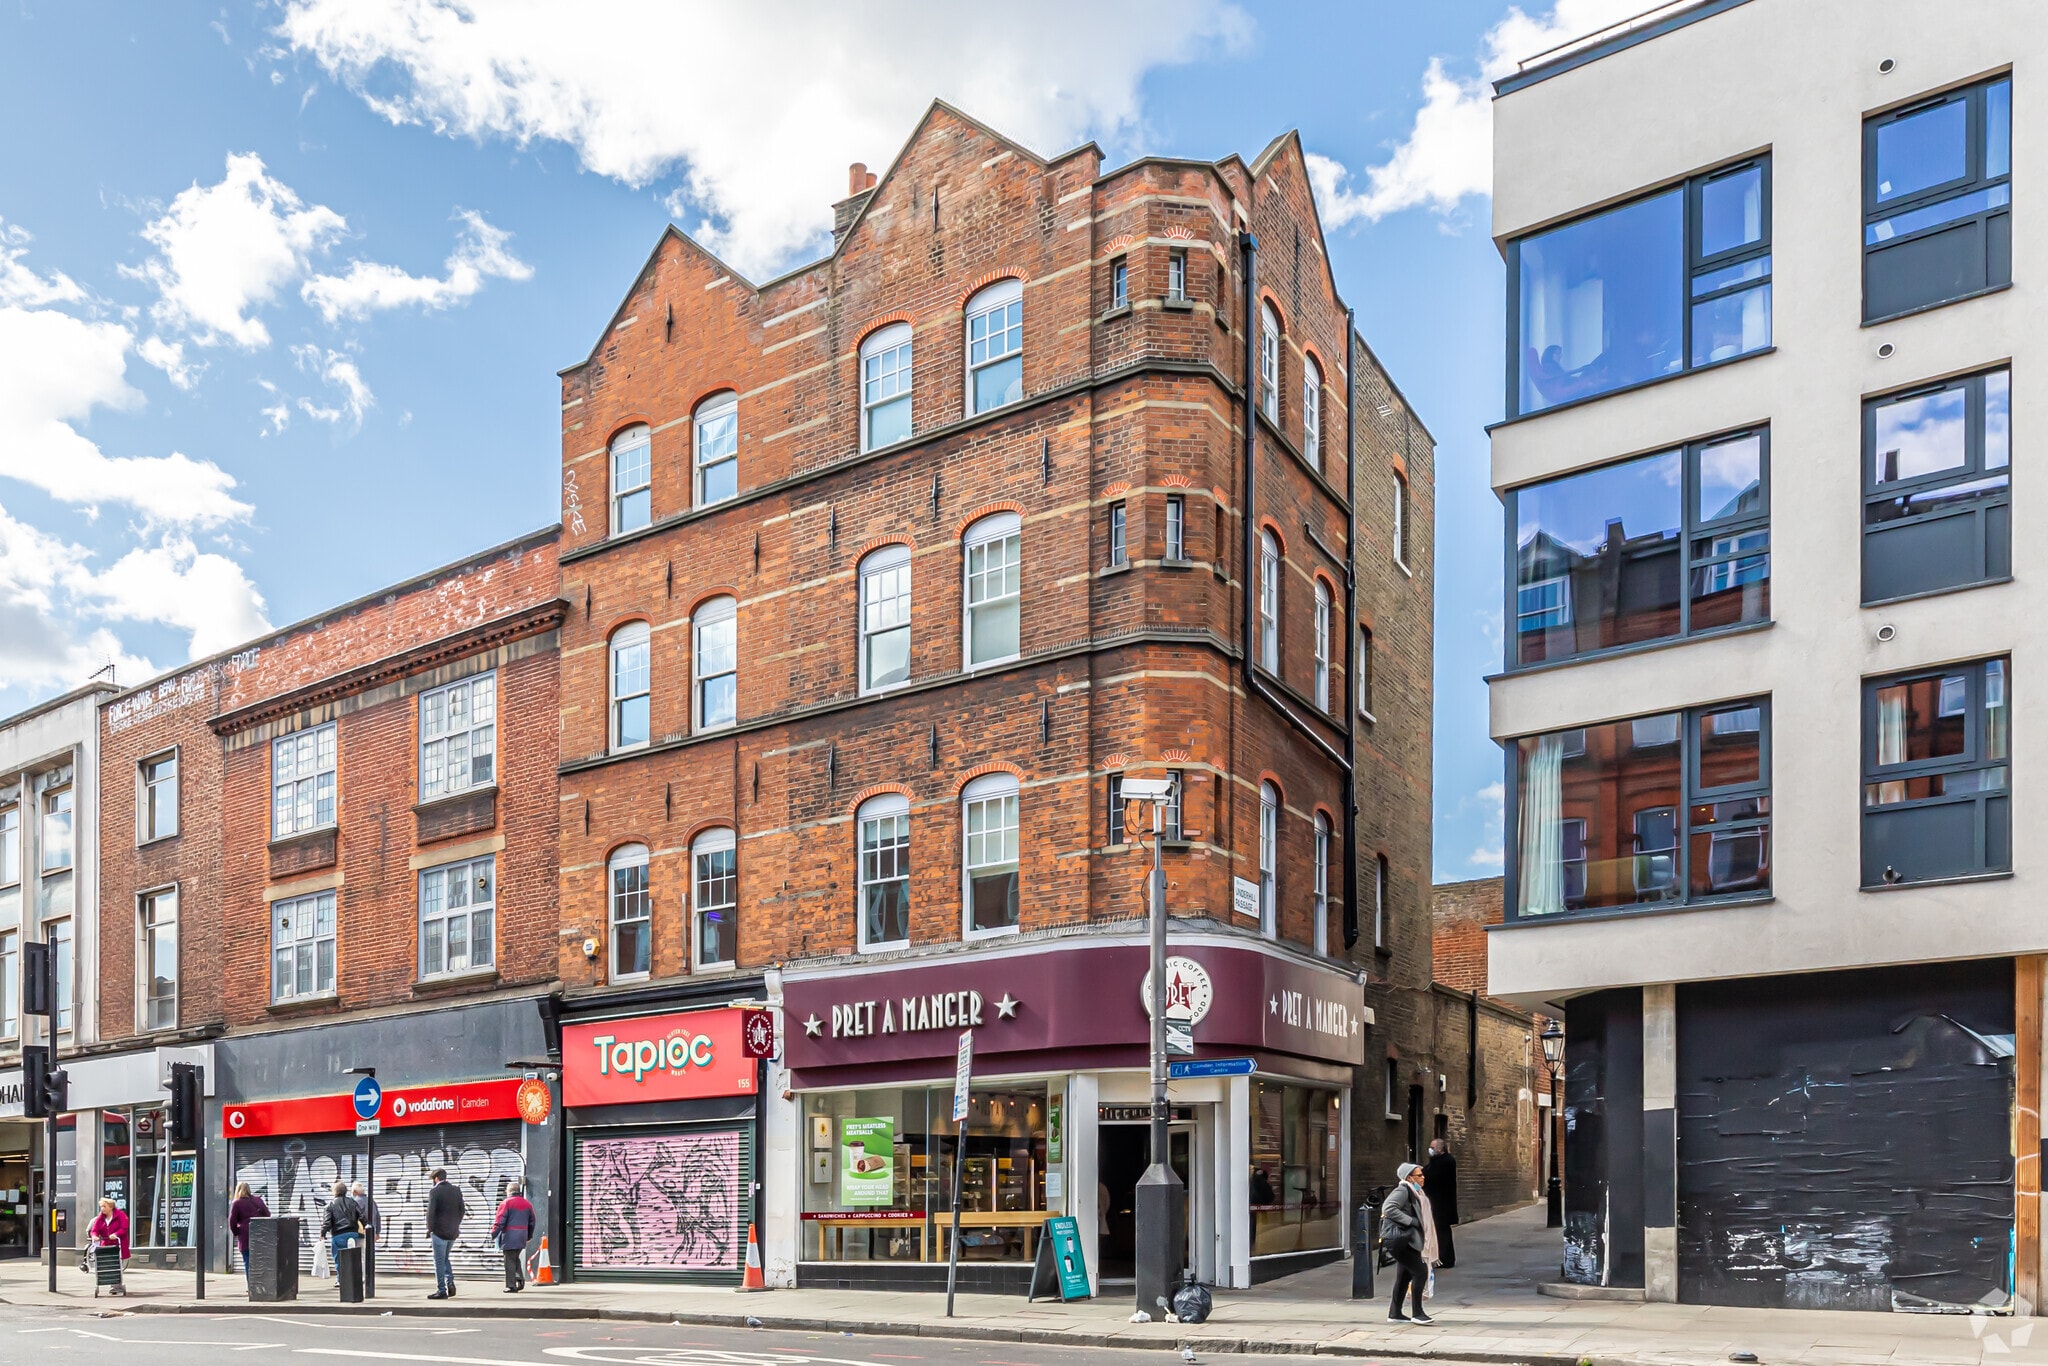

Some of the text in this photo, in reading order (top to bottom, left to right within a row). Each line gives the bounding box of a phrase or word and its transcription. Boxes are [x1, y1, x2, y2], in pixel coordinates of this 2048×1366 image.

[1182, 962, 1208, 988] COFFEE
[832, 990, 984, 1038] PRET A MANGER
[1189, 1001, 1207, 1020] FOOD
[1282, 989, 1348, 1038] PRET A MANGER
[737, 1079, 750, 1089] 155
[408, 1097, 489, 1113] vodafone Camden
[368, 1124, 378, 1133] way
[171, 1160, 194, 1173] ETTER
[105, 1180, 123, 1191] BRING
[165, 1173, 193, 1184] ESHER
